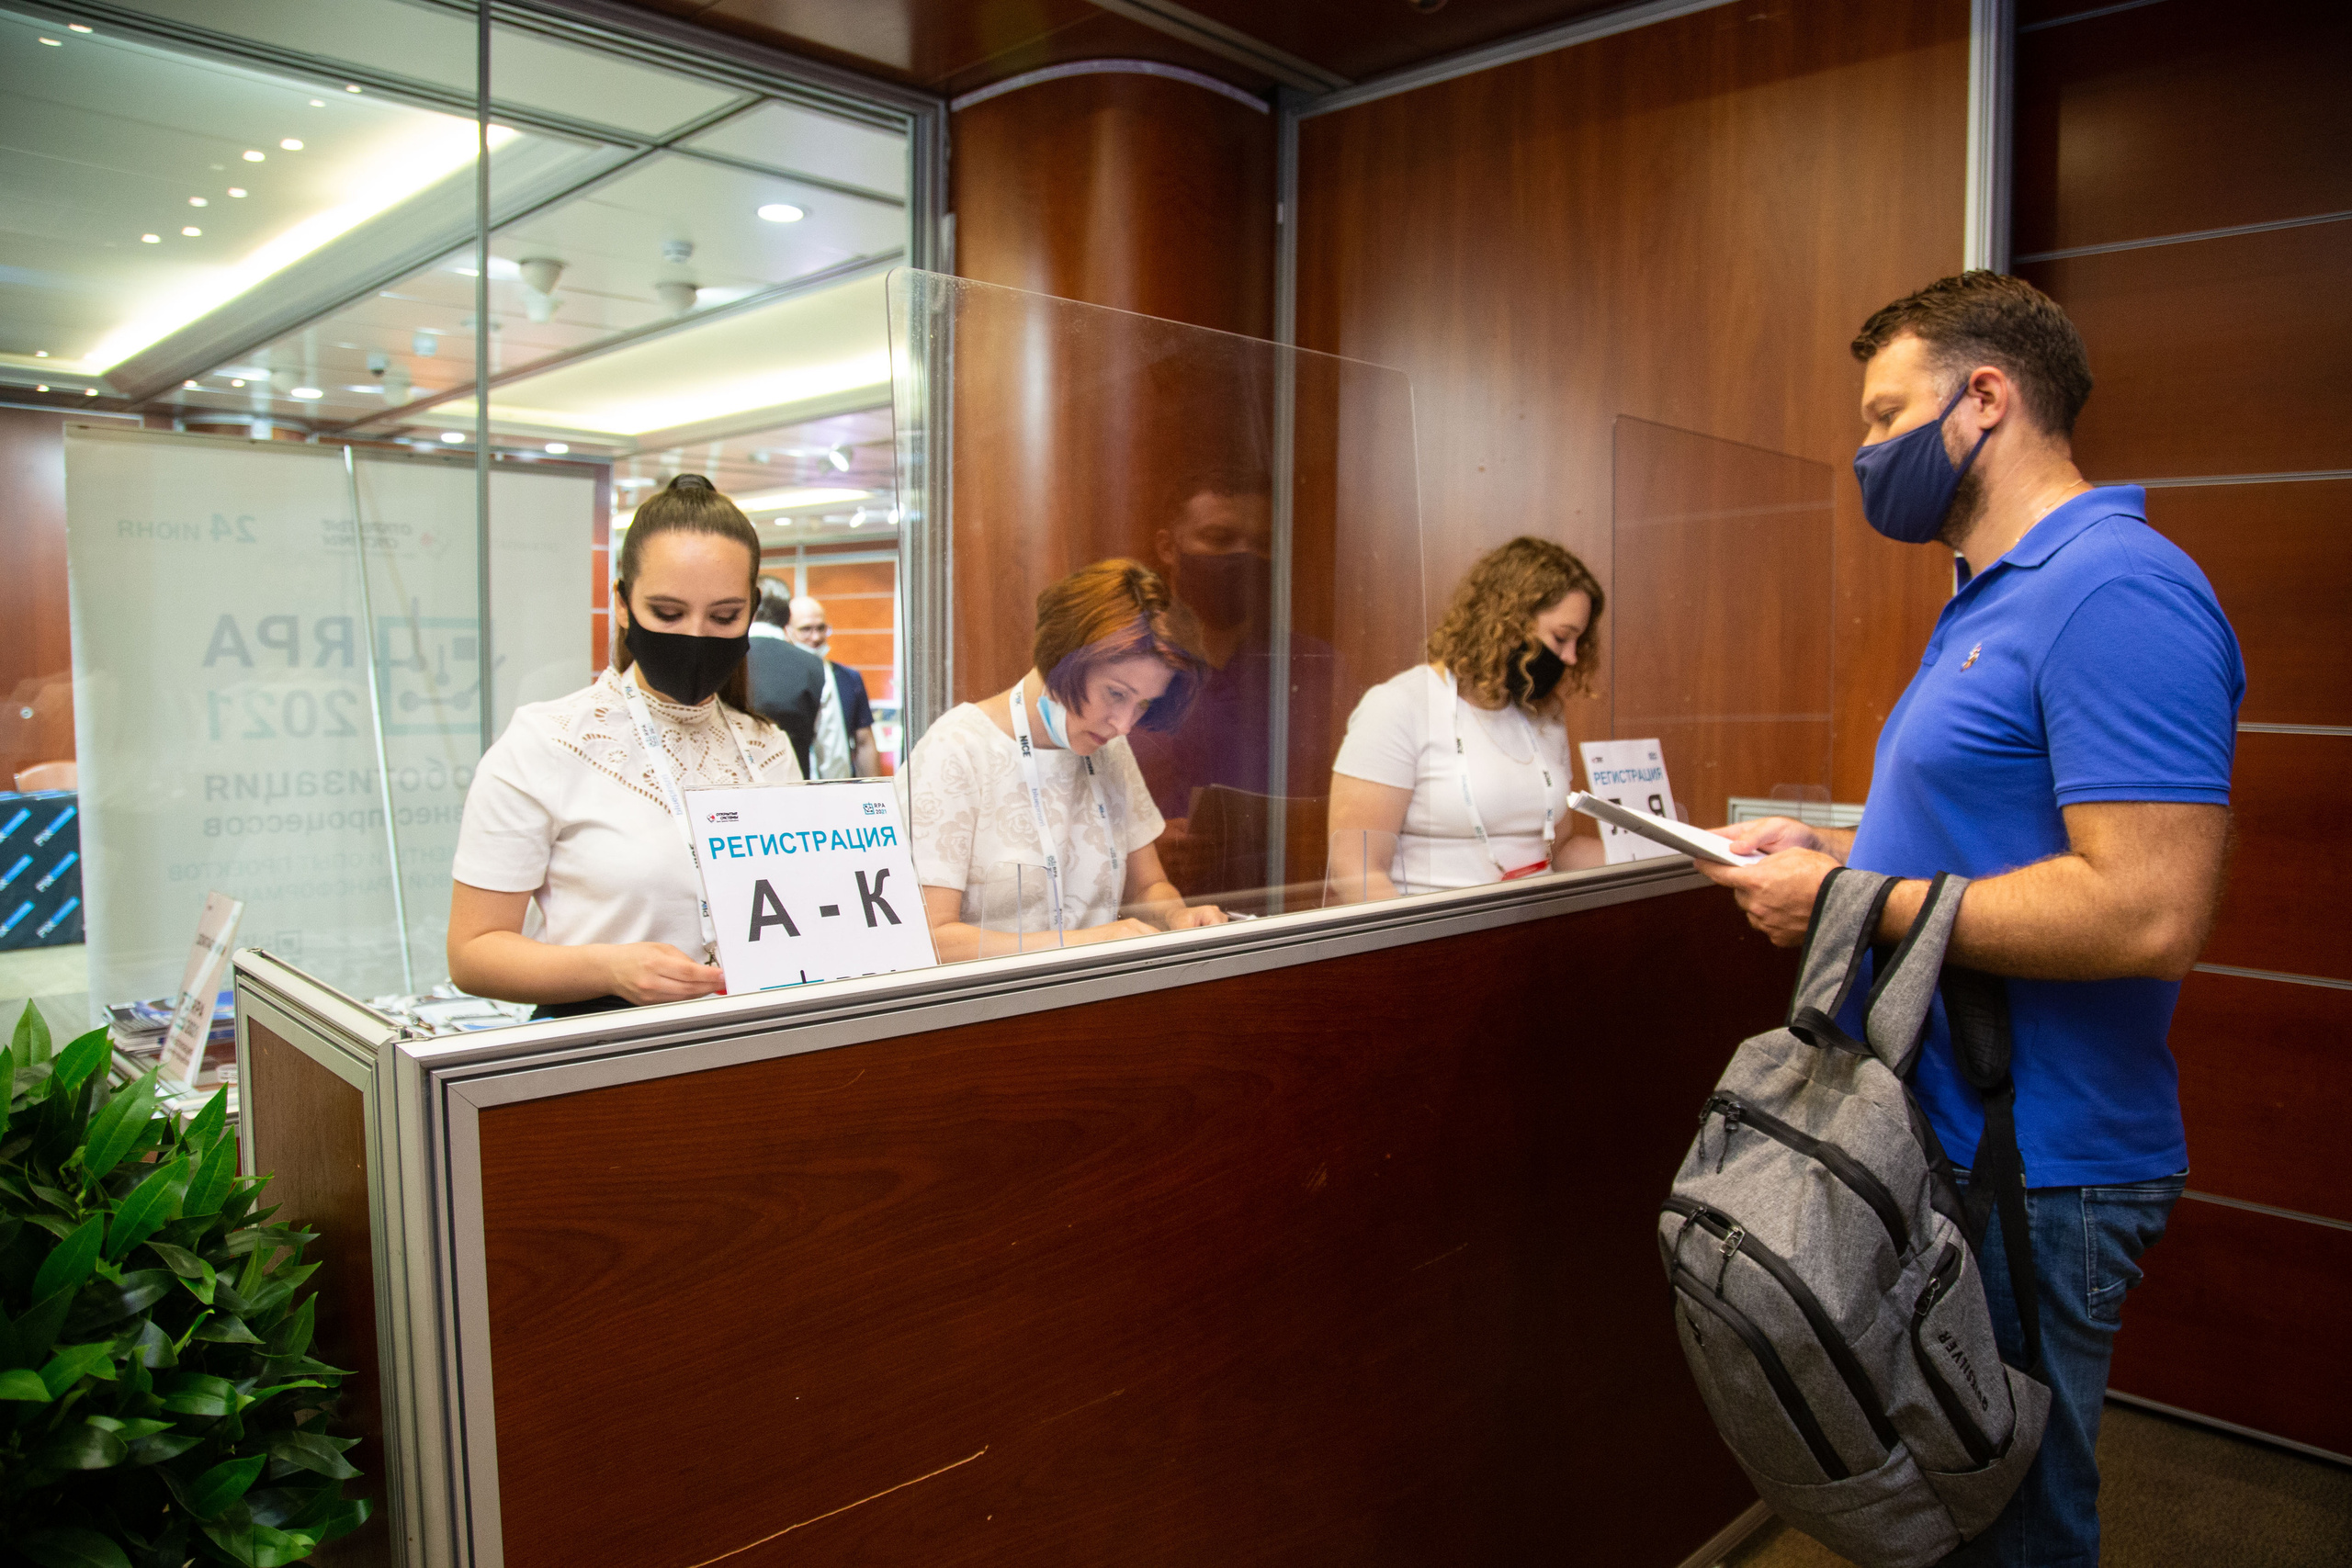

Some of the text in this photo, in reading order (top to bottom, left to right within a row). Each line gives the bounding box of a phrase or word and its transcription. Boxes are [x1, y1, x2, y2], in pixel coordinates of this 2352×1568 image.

[1019, 735, 1032, 758] NICE
[1593, 767, 1663, 785] РЕГИСТРАЦИЯ
[708, 826, 898, 860] РЕГИСТРАЦИЯ
[748, 879, 801, 942] А
[854, 868, 902, 928] К
